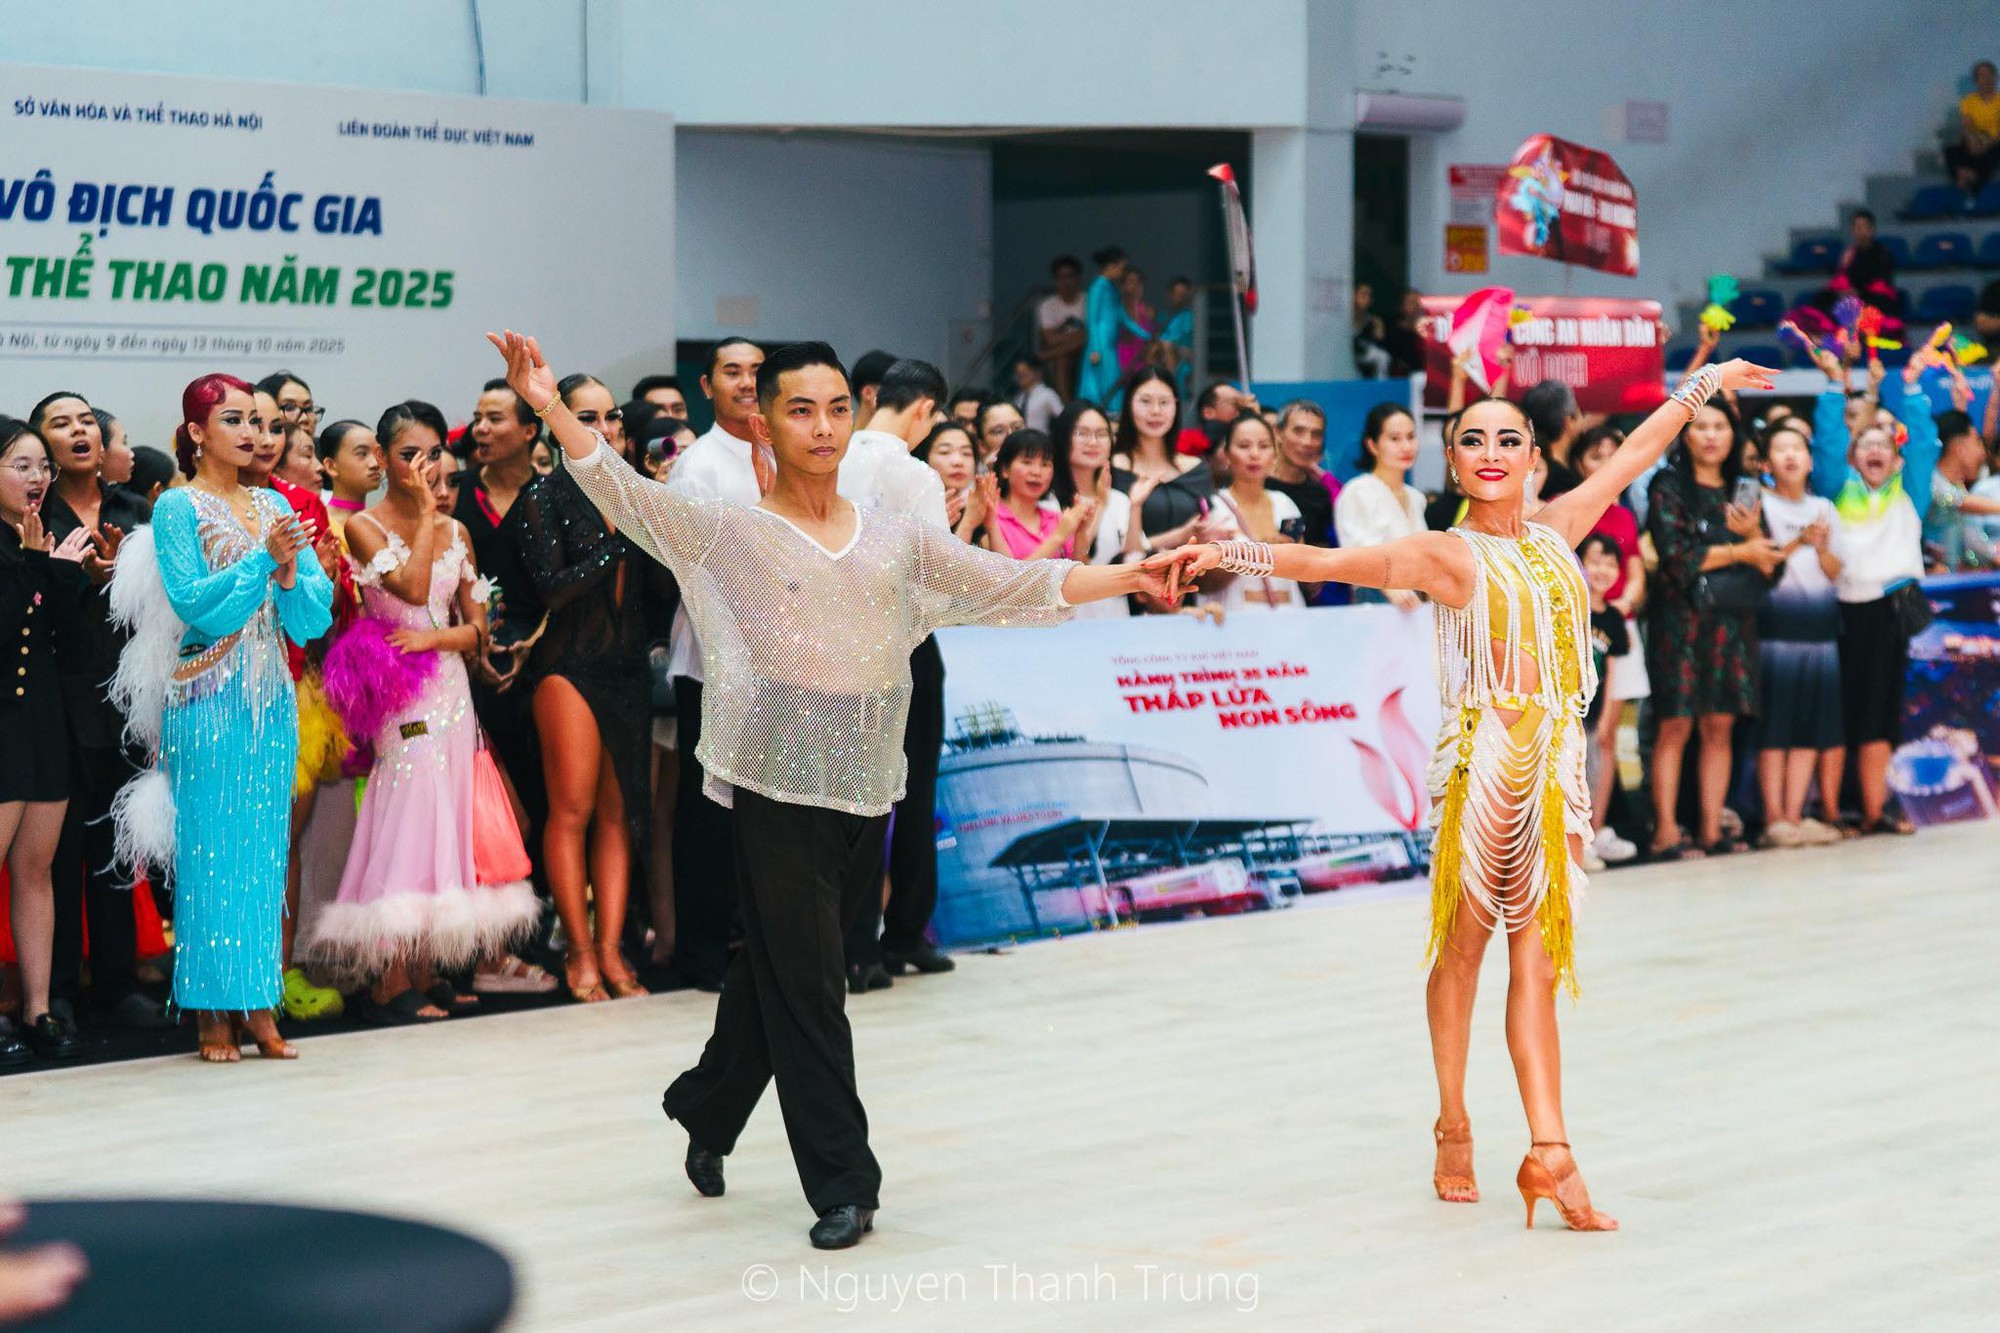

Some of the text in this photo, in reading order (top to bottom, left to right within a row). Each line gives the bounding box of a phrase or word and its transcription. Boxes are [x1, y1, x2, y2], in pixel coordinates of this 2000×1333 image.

[14, 96, 263, 132] SỞ VĂN HÓA VÀ THỂ THAO HÀ NỘI
[338, 119, 369, 136] LIÊN
[373, 120, 411, 139] ĐOÀN
[474, 126, 501, 147] VIỆT
[505, 131, 535, 147] NAM
[0, 168, 383, 238] VÔ ĐỊCH QUỐC GIA
[6, 232, 455, 308] THỂ THAO NĂM 2025
[64, 334, 100, 352] ngày
[107, 334, 116, 349] 9
[121, 331, 148, 348] đến
[152, 335, 187, 354] ngày
[212, 336, 252, 354] tháng
[258, 336, 273, 351] 10
[309, 336, 345, 352] 2025
[1117, 669, 1175, 688] HÀNH
[1179, 666, 1237, 684] TRÌNH
[1266, 660, 1310, 679] NĂM
[1218, 699, 1358, 730] NON SÔNG
